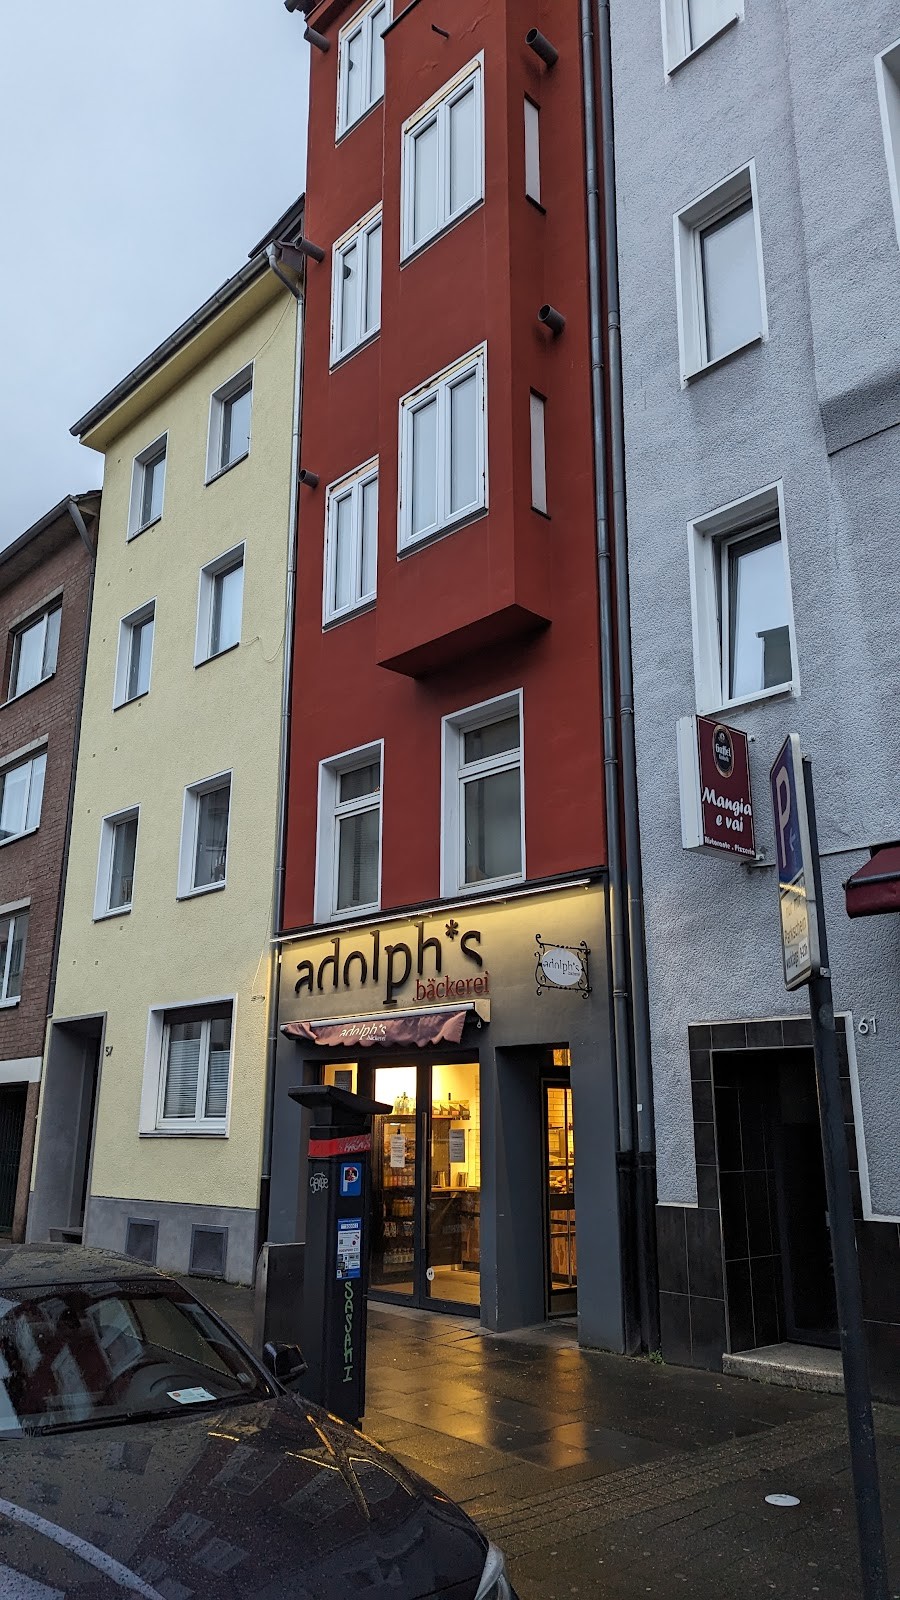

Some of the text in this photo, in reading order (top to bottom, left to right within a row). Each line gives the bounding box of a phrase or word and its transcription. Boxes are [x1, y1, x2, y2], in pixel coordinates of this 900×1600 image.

[702, 787, 752, 816] Mangia
[715, 814, 744, 832] e vai
[858, 1016, 877, 1034] 61
